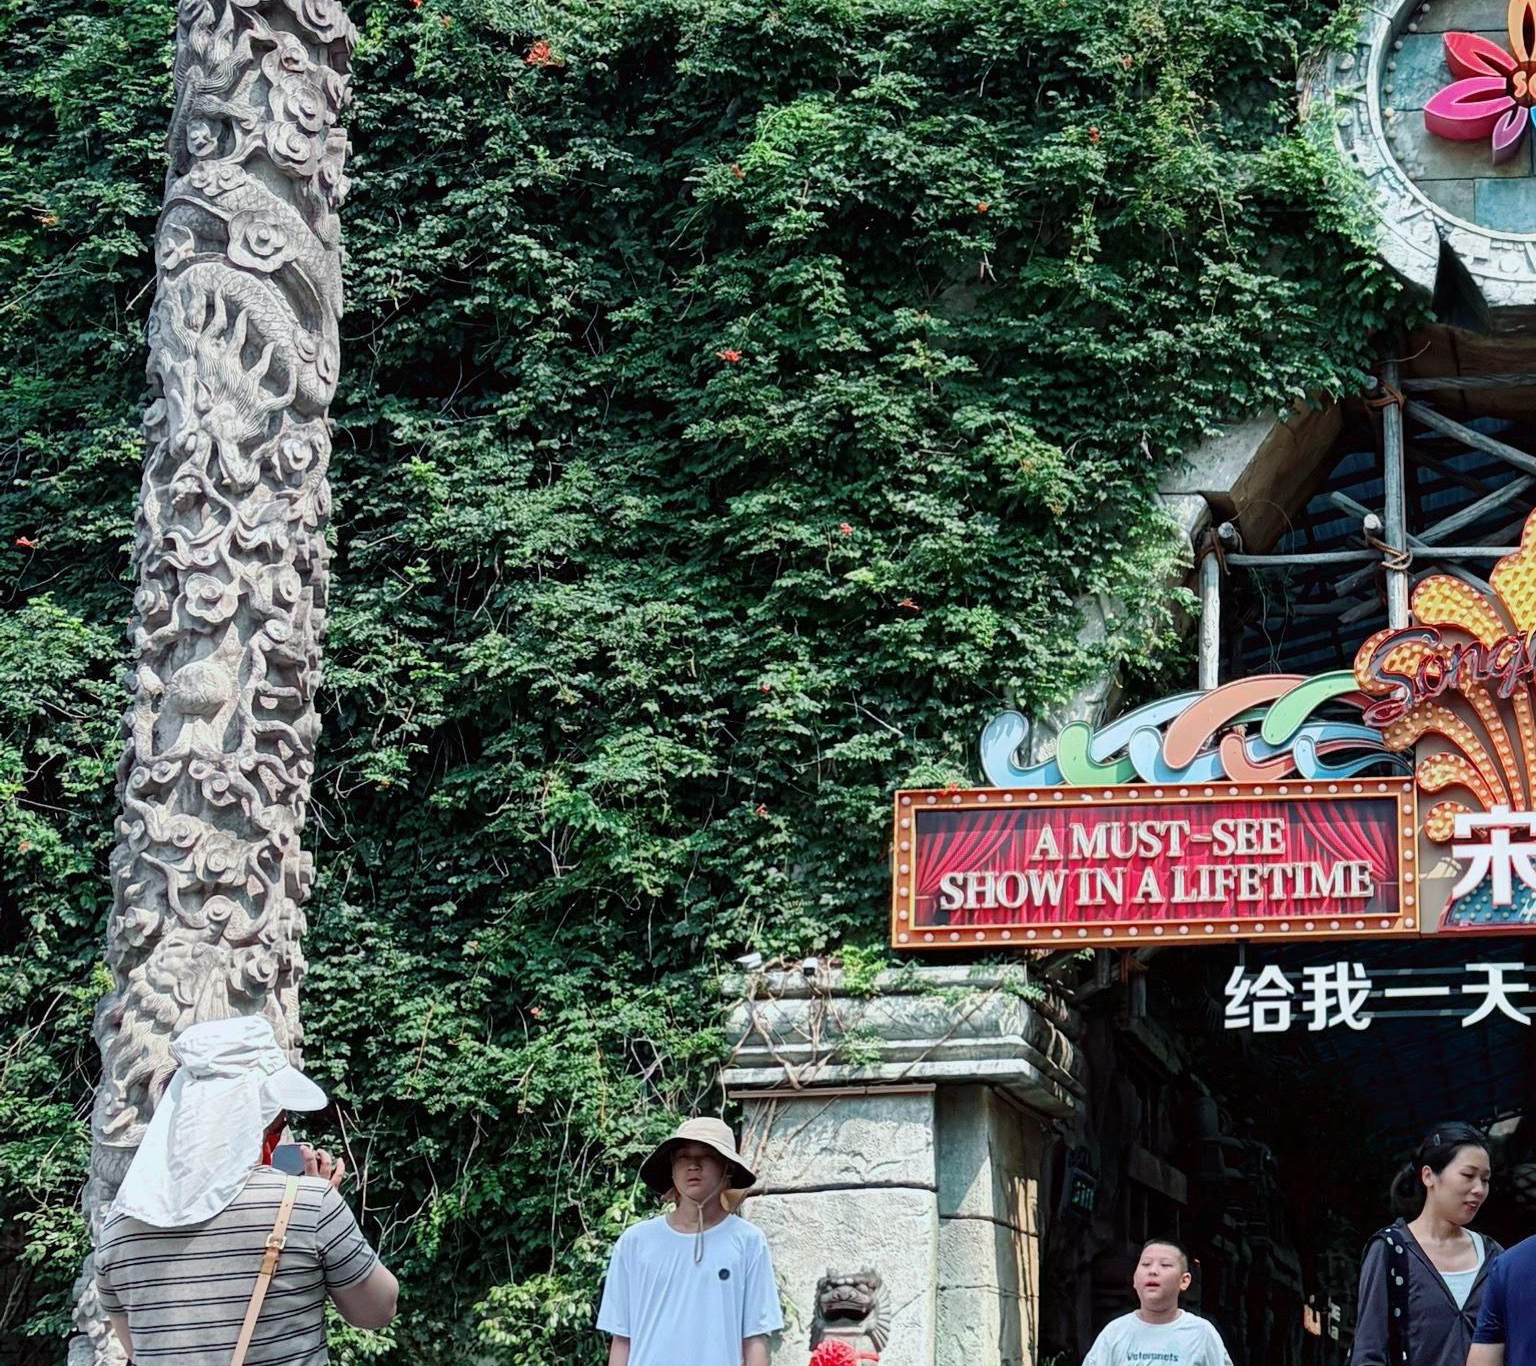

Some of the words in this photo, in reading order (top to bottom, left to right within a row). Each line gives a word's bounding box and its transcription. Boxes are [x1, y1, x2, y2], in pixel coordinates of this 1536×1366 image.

[1030, 823, 1060, 861] A
[1069, 817, 1287, 860] MUST-SEE
[939, 867, 1069, 911] SHOW
[1075, 866, 1126, 906] IN
[1132, 864, 1167, 903] A
[1170, 861, 1375, 903] LIFETIME
[1223, 959, 1532, 1033] 给我一天
